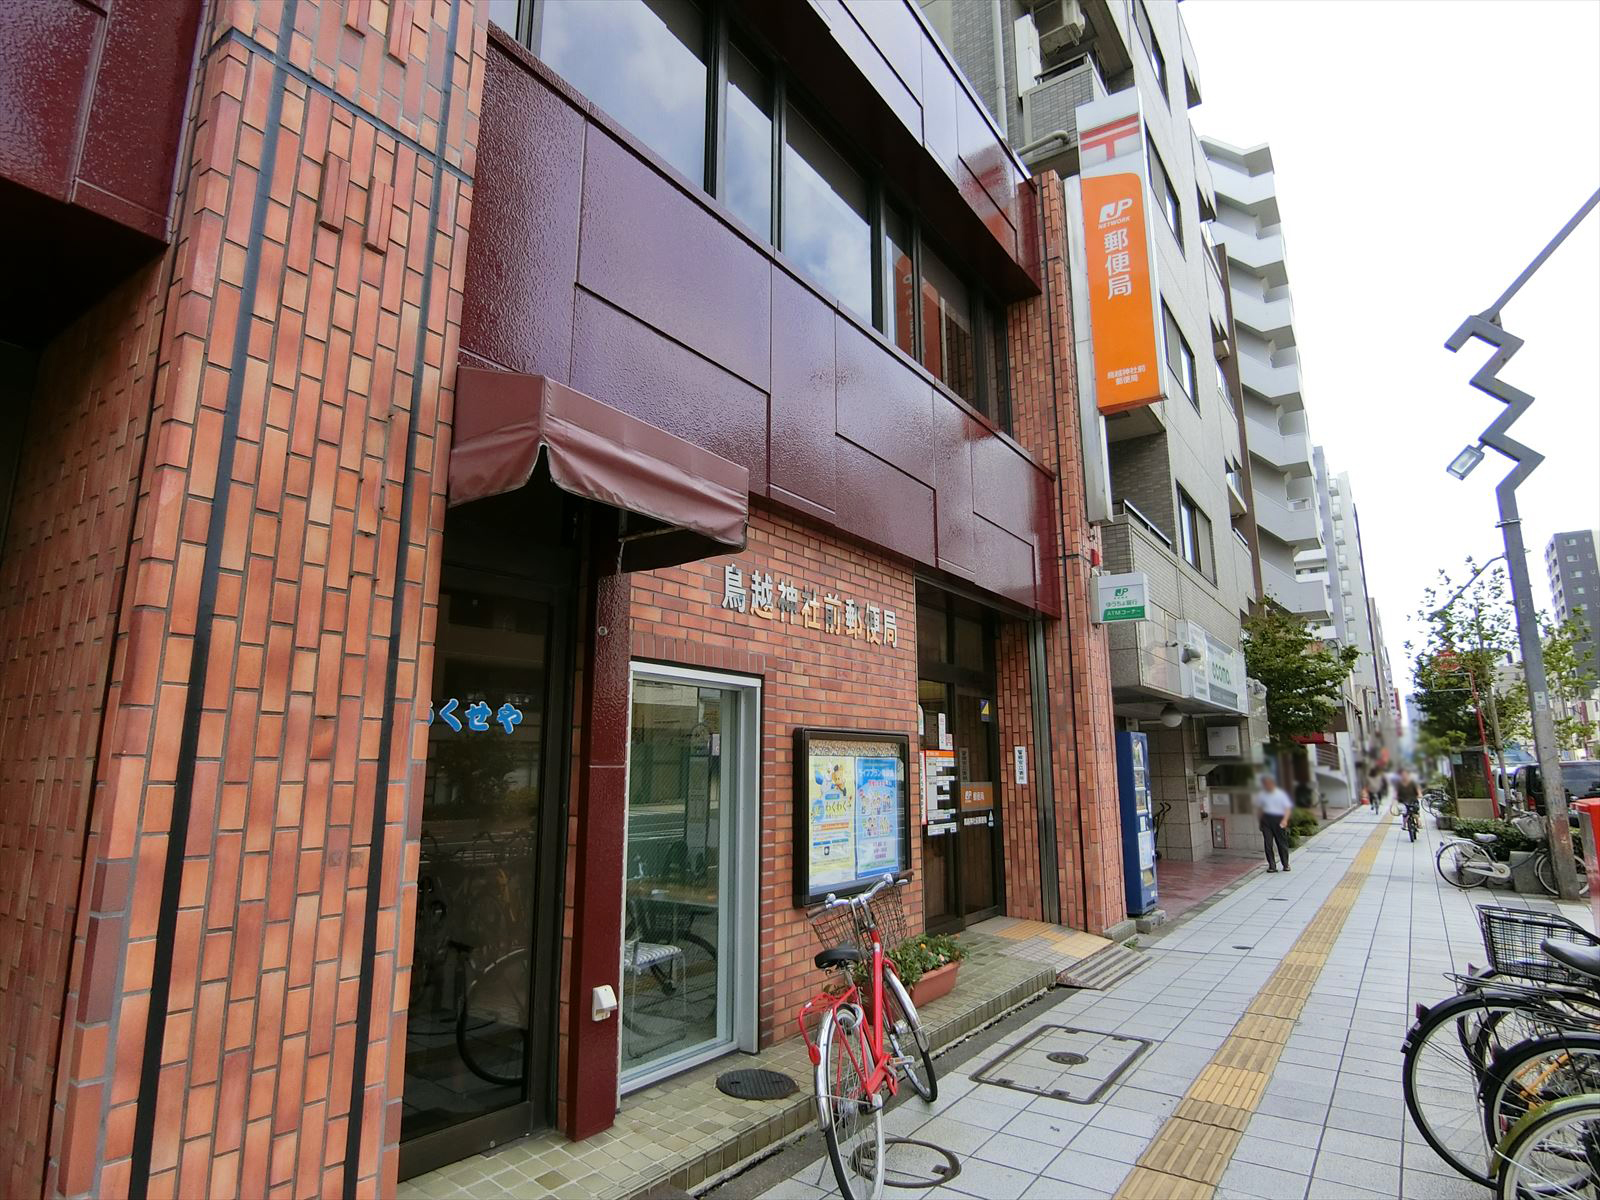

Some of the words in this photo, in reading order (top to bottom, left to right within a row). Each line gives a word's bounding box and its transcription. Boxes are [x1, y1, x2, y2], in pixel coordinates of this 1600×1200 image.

[1098, 215, 1131, 230] NETWORK
[1099, 198, 1133, 223] JP
[1104, 228, 1132, 300] 郵便局
[722, 563, 898, 648] 鳥越神社前郵便局
[1106, 608, 1142, 617] ATMコーナー
[429, 698, 523, 734] くせや
